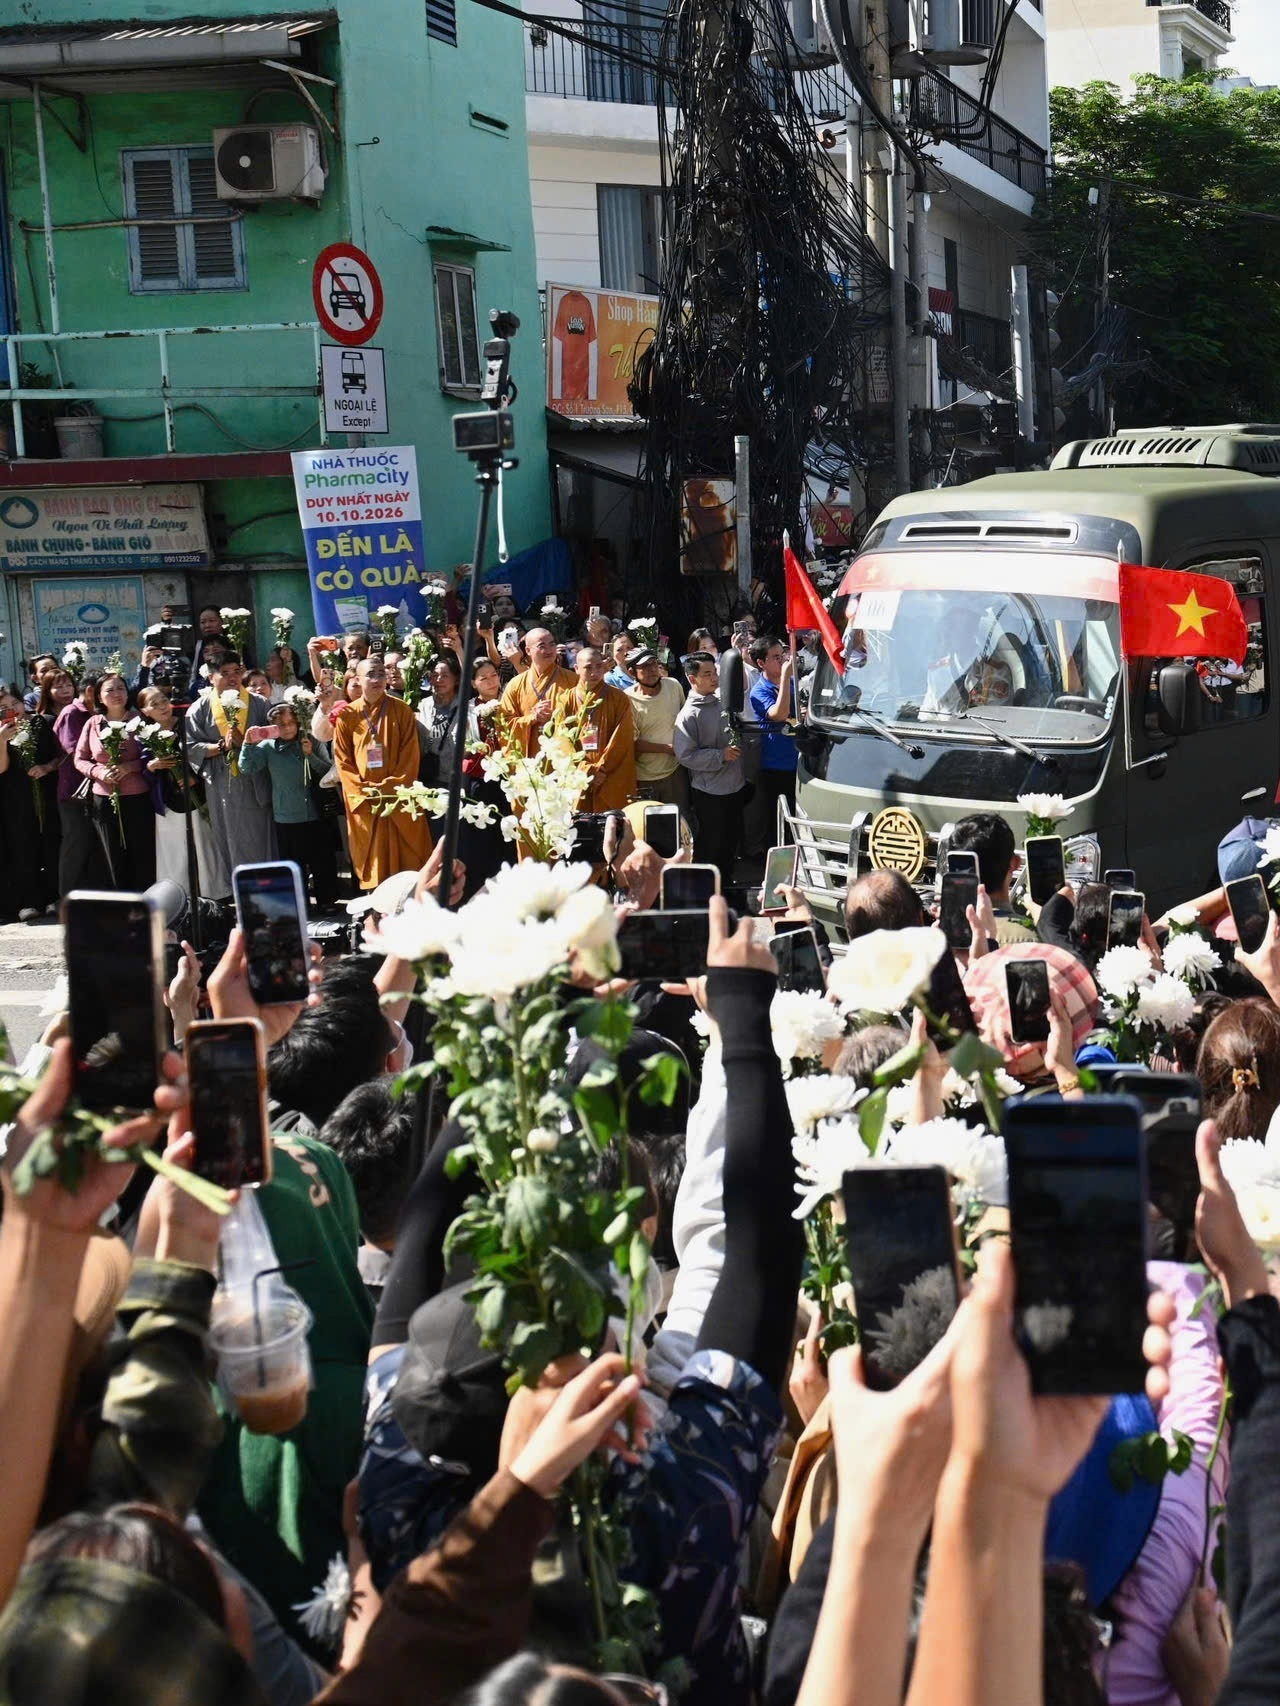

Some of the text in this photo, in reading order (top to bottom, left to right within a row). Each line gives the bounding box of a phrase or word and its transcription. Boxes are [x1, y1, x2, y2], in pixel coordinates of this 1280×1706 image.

[608, 296, 660, 326] Shop Hàn
[334, 398, 377, 414] NGOẠI LỆ
[343, 416, 371, 429] Except
[312, 452, 399, 470] NHÀ THUỐC
[304, 467, 409, 488] Pharmacity
[306, 491, 410, 509] DUY NHẤT NGÀY
[317, 507, 404, 523] 10.10.2026
[6, 534, 39, 553] BÁNH
[92, 533, 126, 551] BÁNH
[129, 532, 153, 550] GIÒ
[316, 528, 414, 559] ĐẾN LÀ
[316, 559, 421, 591] CÓ QUÀ
